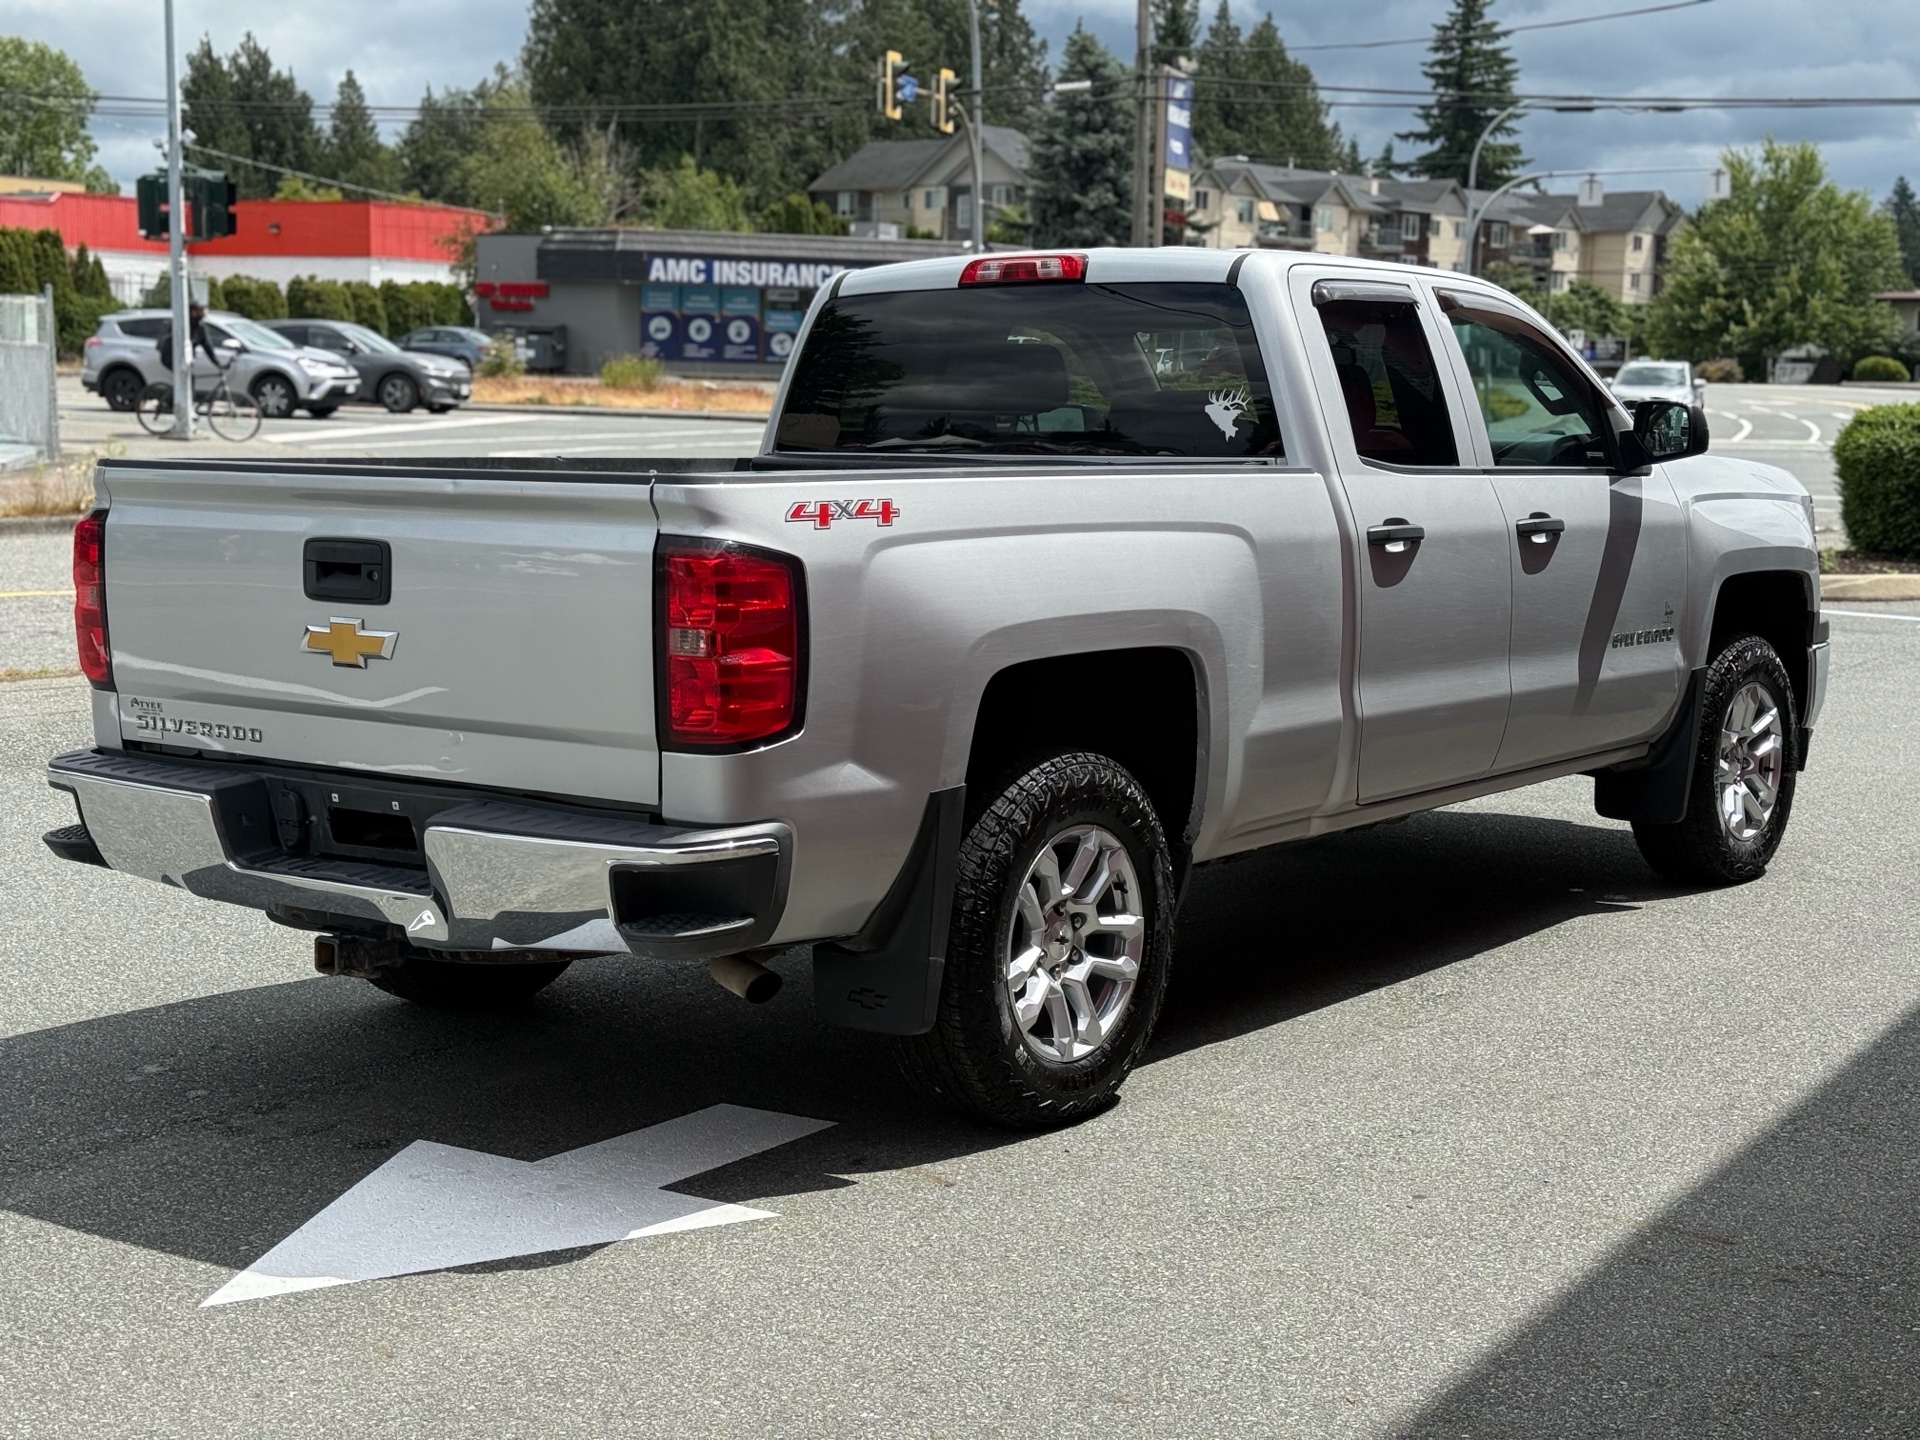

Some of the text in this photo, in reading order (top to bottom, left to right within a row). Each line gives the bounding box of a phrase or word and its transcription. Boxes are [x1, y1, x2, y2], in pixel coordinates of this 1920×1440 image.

[650, 257, 846, 288] AMC INSURANC
[135, 714, 263, 743] SILVERADO
